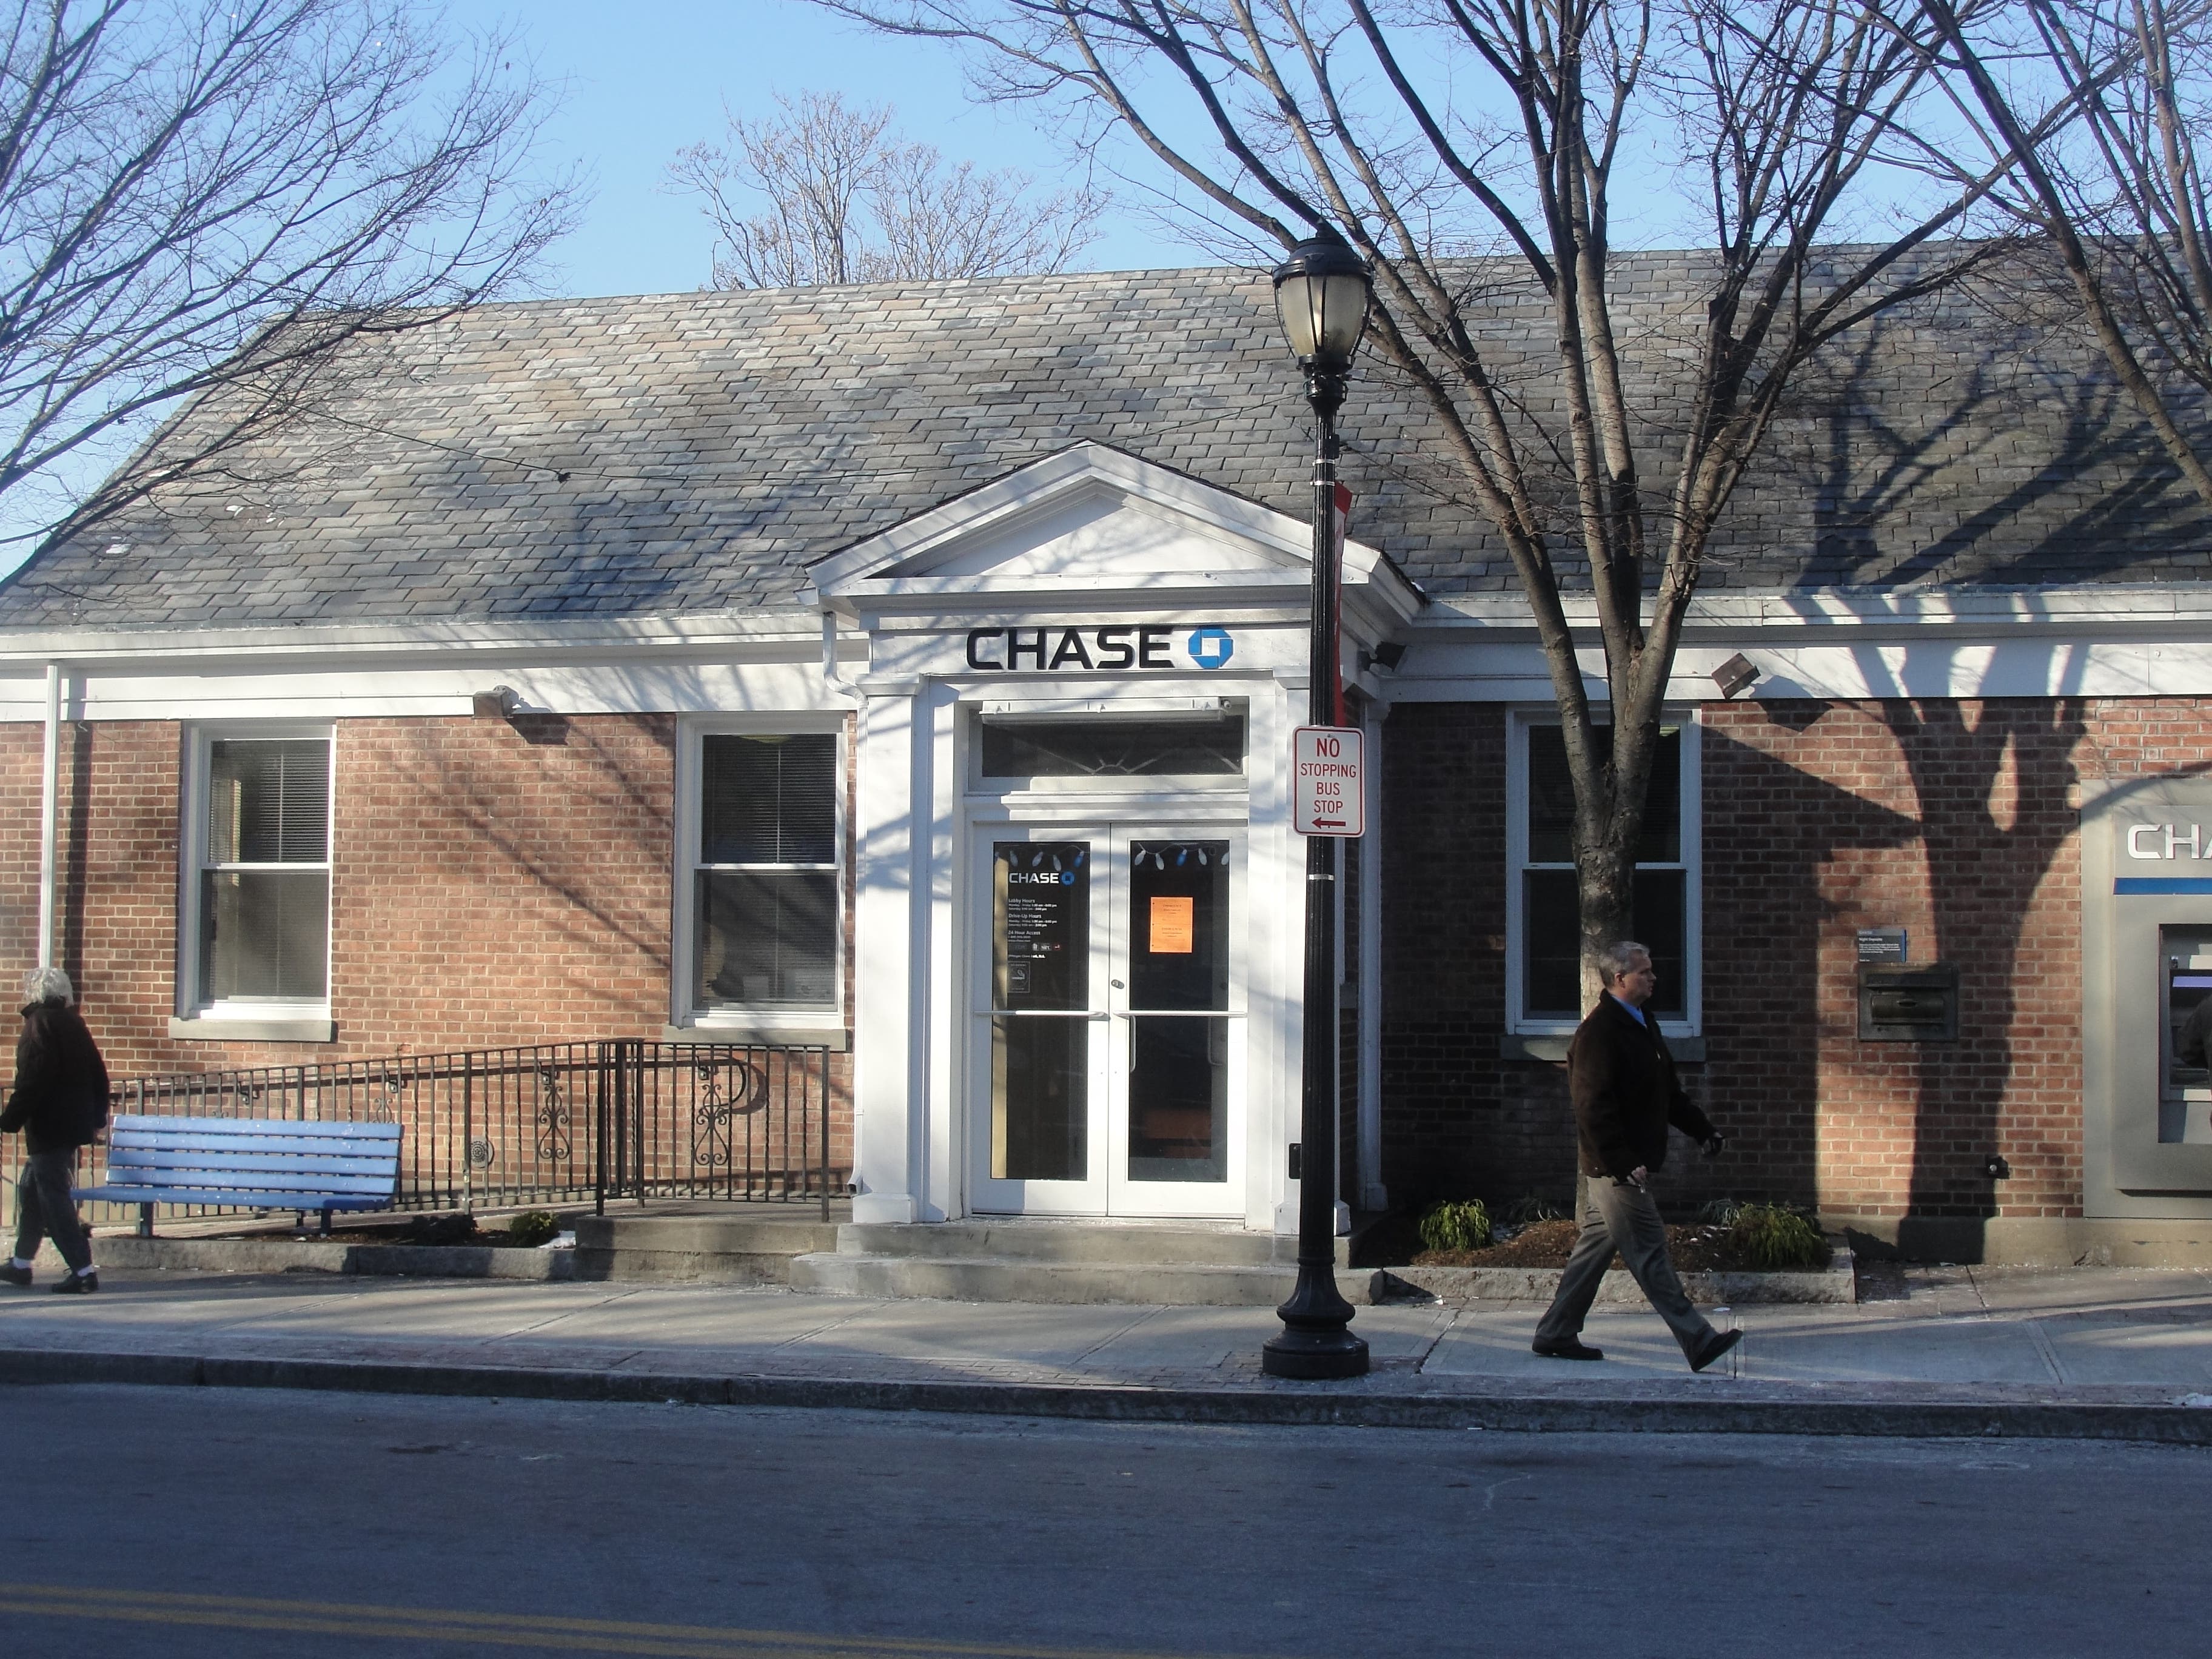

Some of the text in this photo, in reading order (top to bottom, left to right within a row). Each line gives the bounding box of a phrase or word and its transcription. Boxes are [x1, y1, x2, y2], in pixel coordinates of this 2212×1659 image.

[967, 626, 1175, 670] CHASE
[1316, 738, 1340, 758] NO
[1301, 763, 1356, 778] STOPPING
[1316, 782, 1340, 796] BUS
[1313, 800, 1344, 814] STOP
[2127, 824, 2212, 859] CH
[1009, 873, 1059, 884] CHASE
